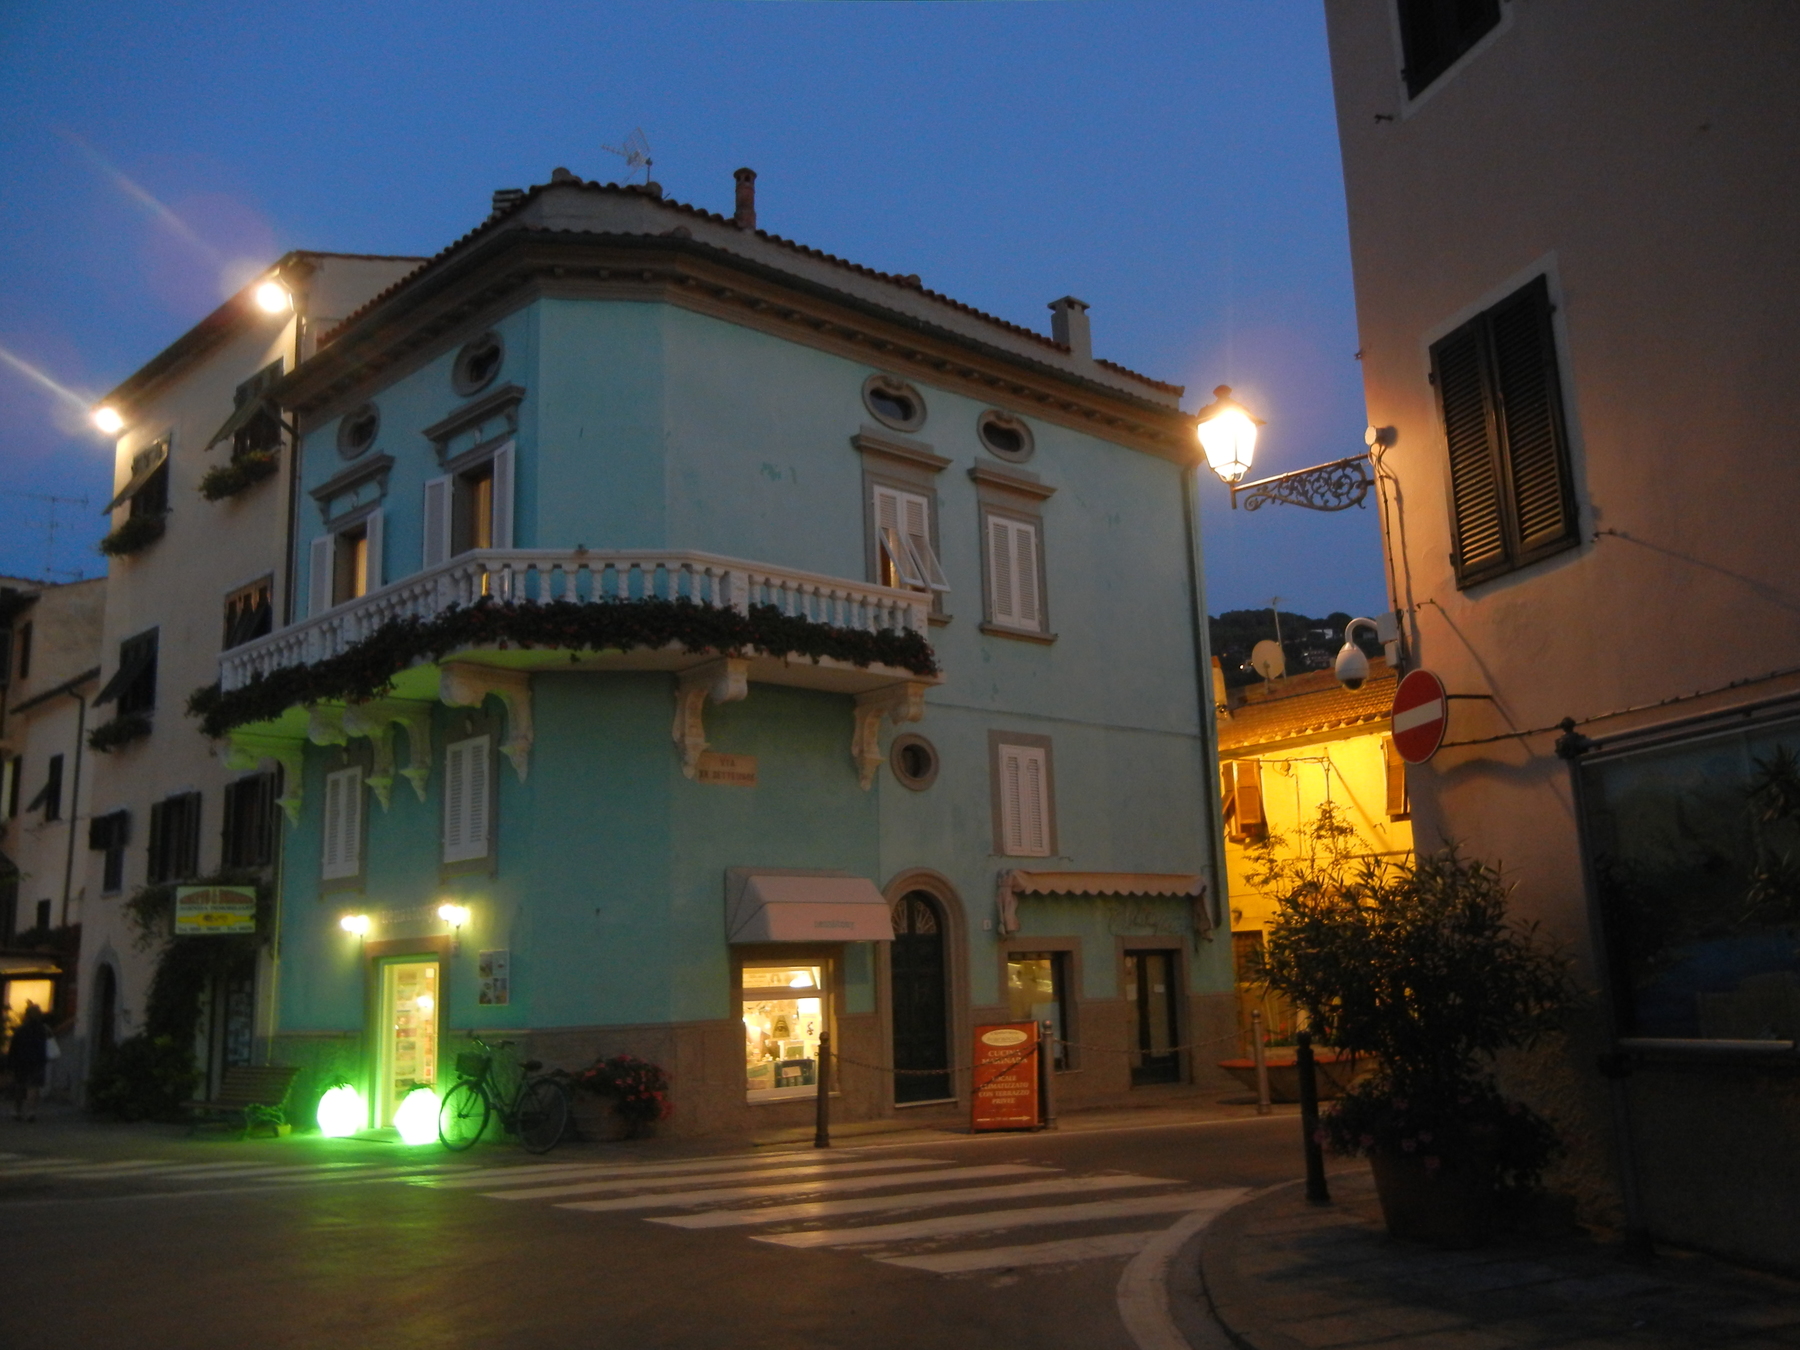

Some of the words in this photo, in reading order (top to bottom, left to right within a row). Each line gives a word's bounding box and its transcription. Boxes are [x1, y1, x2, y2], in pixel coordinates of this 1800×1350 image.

[719, 758, 736, 766] VIA
[988, 1049, 1021, 1057] CUCINA
[995, 1089, 1030, 1097] TERRAZZO
